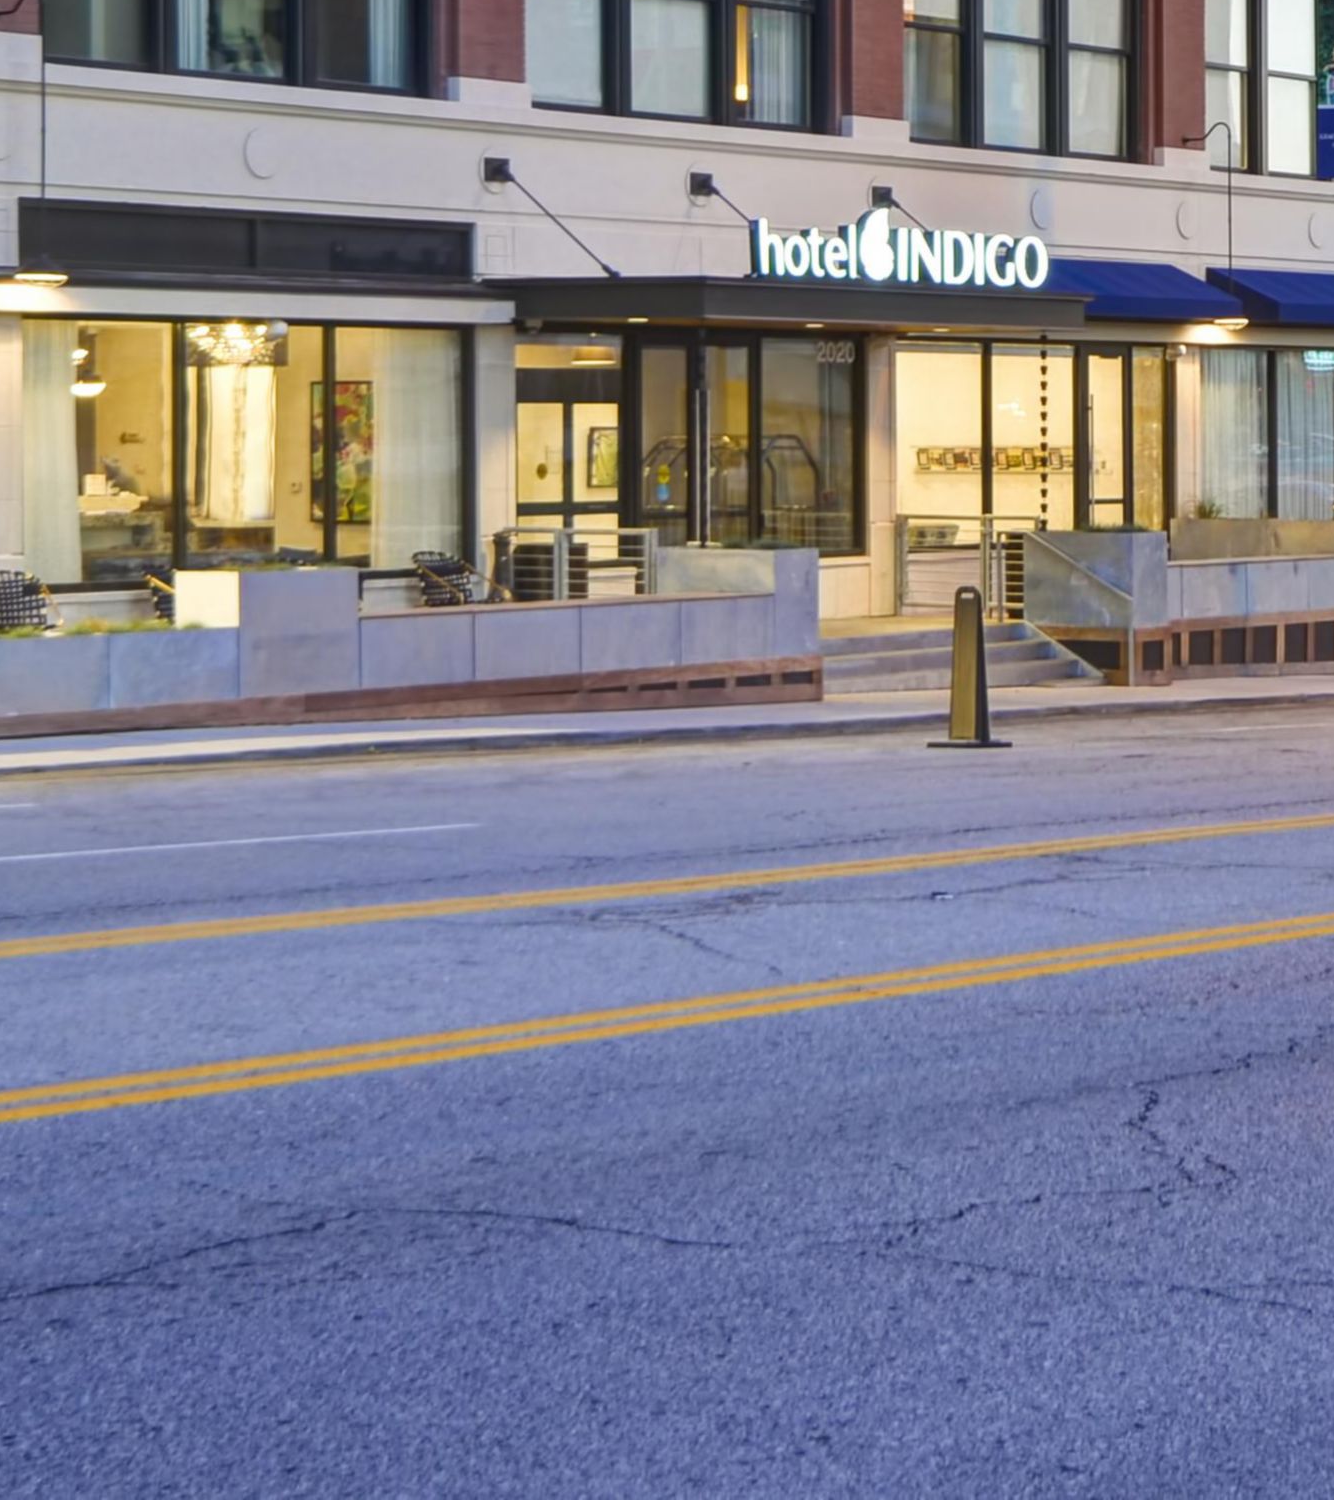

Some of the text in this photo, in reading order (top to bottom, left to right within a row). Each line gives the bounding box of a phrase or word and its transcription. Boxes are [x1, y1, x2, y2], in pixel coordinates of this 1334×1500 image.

[757, 218, 1049, 289] hotel INDIGO
[816, 341, 856, 364] 2020
